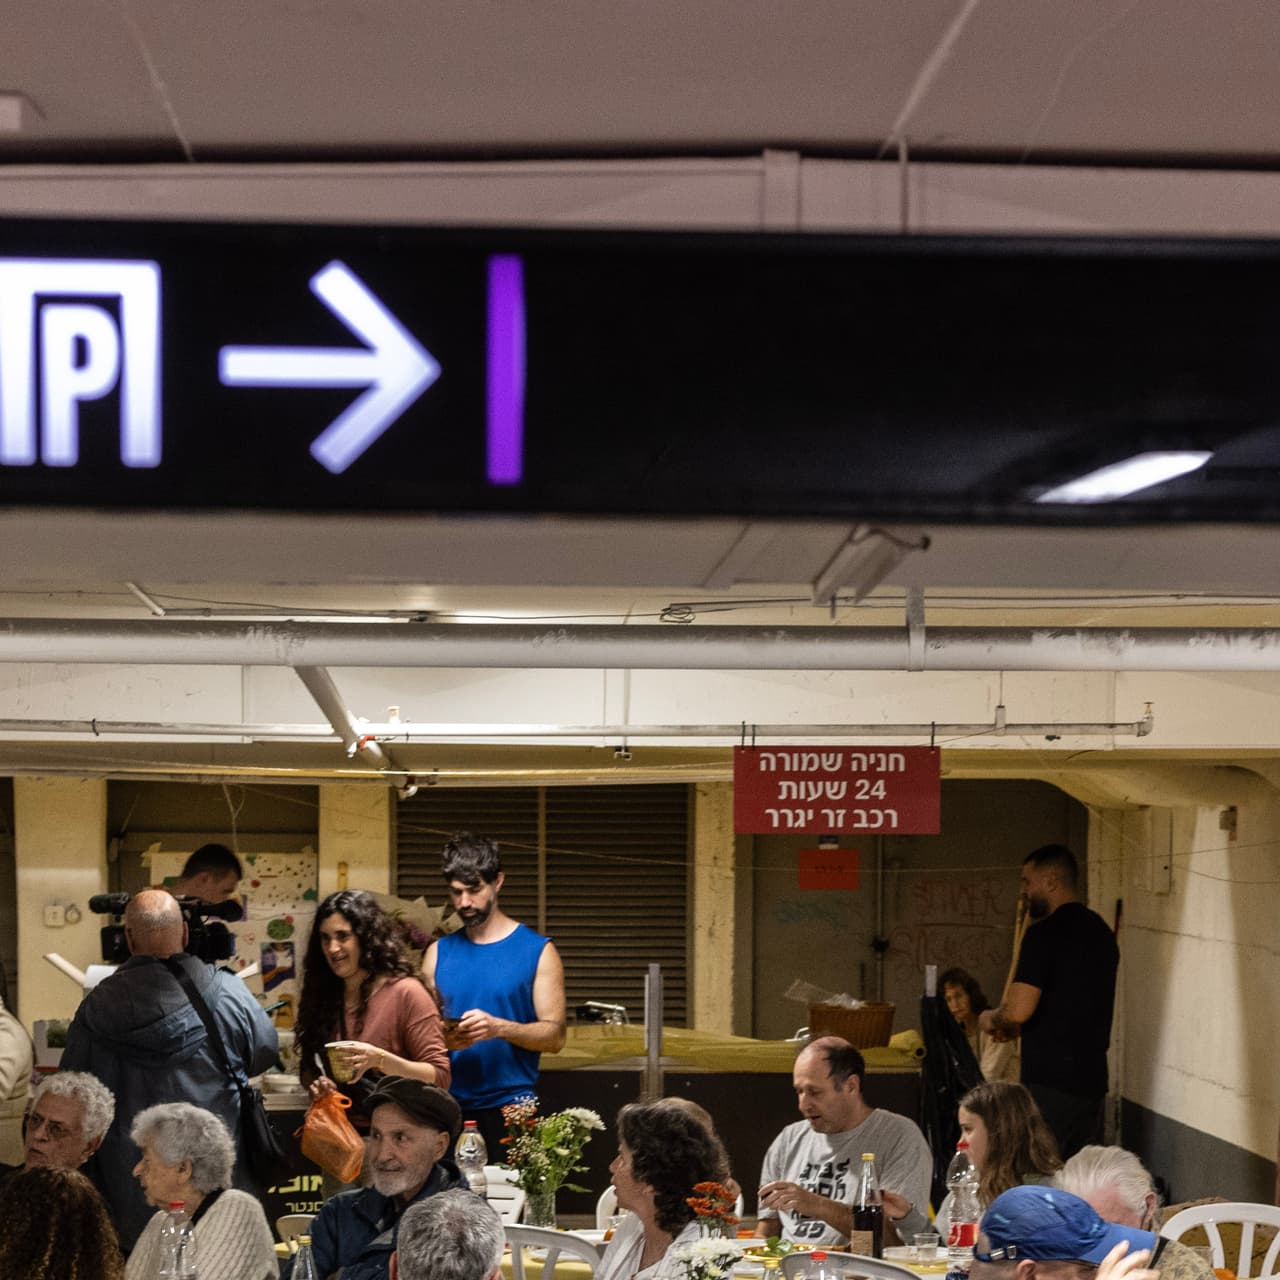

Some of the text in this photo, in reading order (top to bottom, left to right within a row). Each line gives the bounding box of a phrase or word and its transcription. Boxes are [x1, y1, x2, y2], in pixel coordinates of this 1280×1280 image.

[759, 752, 906, 773] חניה שמורה
[777, 779, 888, 801] 24 שעות
[765, 808, 899, 829] רכב זר יגרר
